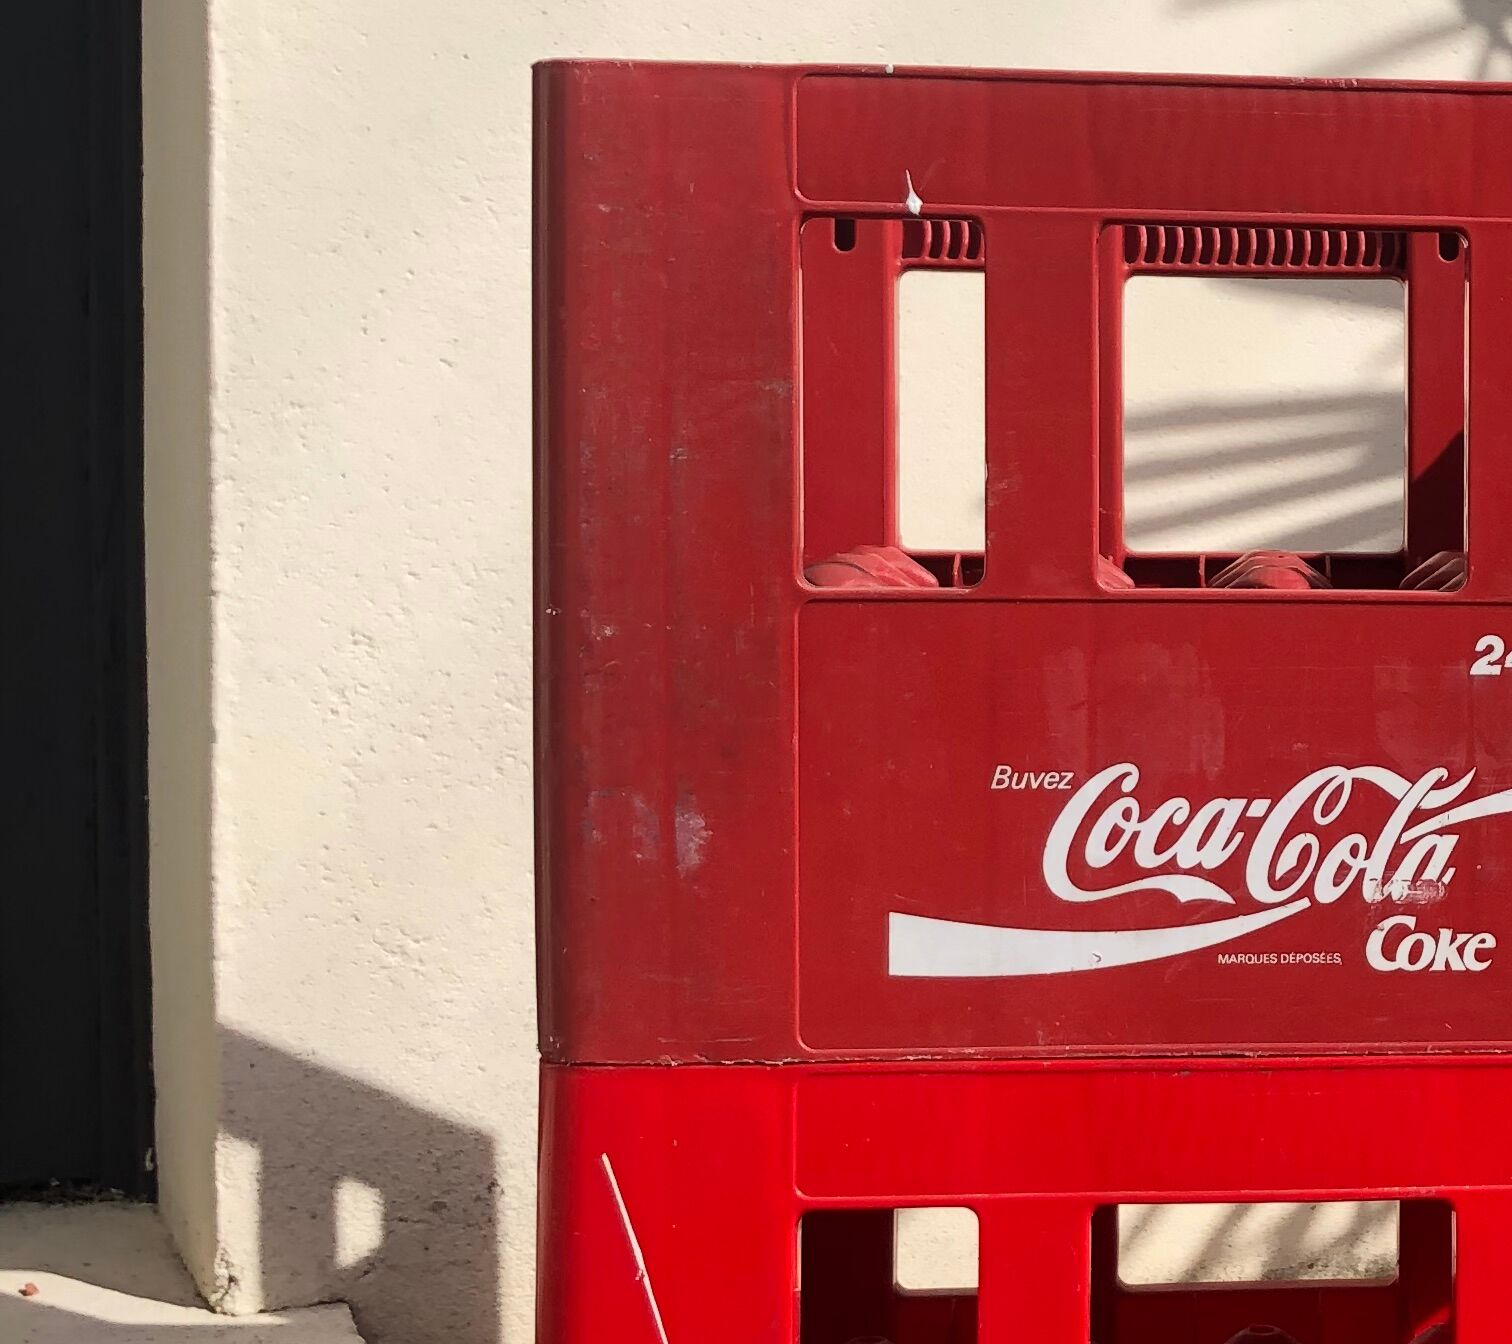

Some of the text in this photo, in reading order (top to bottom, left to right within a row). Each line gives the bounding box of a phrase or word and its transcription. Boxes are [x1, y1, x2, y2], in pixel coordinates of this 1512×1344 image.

[990, 762, 1477, 905] Buvez Coca-Cola
[1217, 953, 1278, 965] MARQUES
[1365, 914, 1497, 972] Coke
